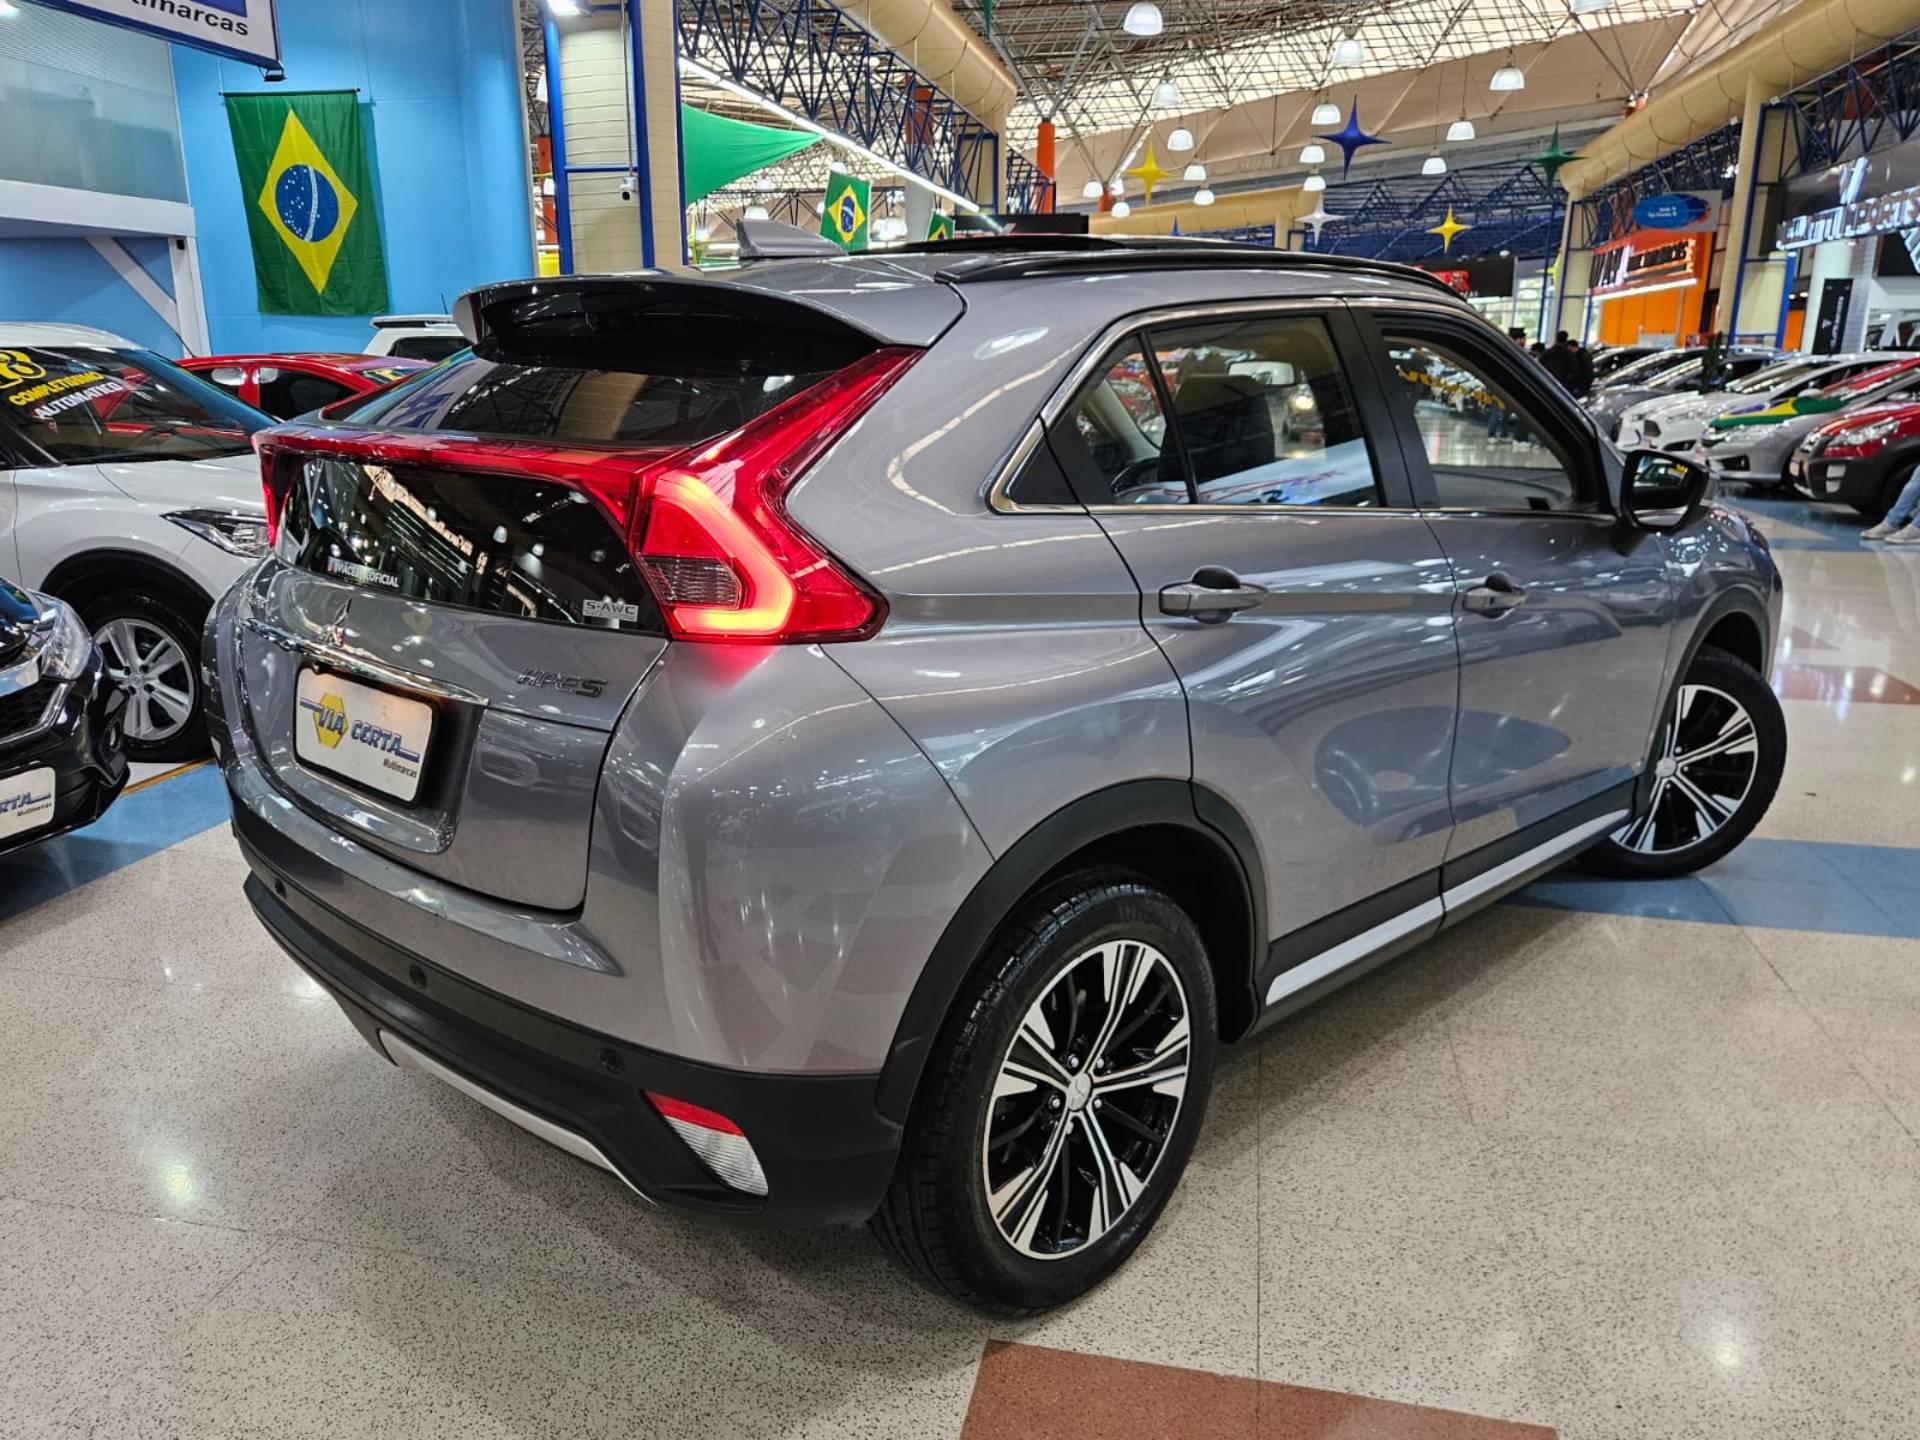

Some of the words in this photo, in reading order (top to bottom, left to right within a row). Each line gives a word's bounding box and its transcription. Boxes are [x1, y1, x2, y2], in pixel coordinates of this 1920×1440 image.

[585, 600, 637, 616] S-AWC
[317, 705, 345, 736] VIA
[350, 719, 403, 756] CERTA
[382, 756, 418, 779] Multimarcas
